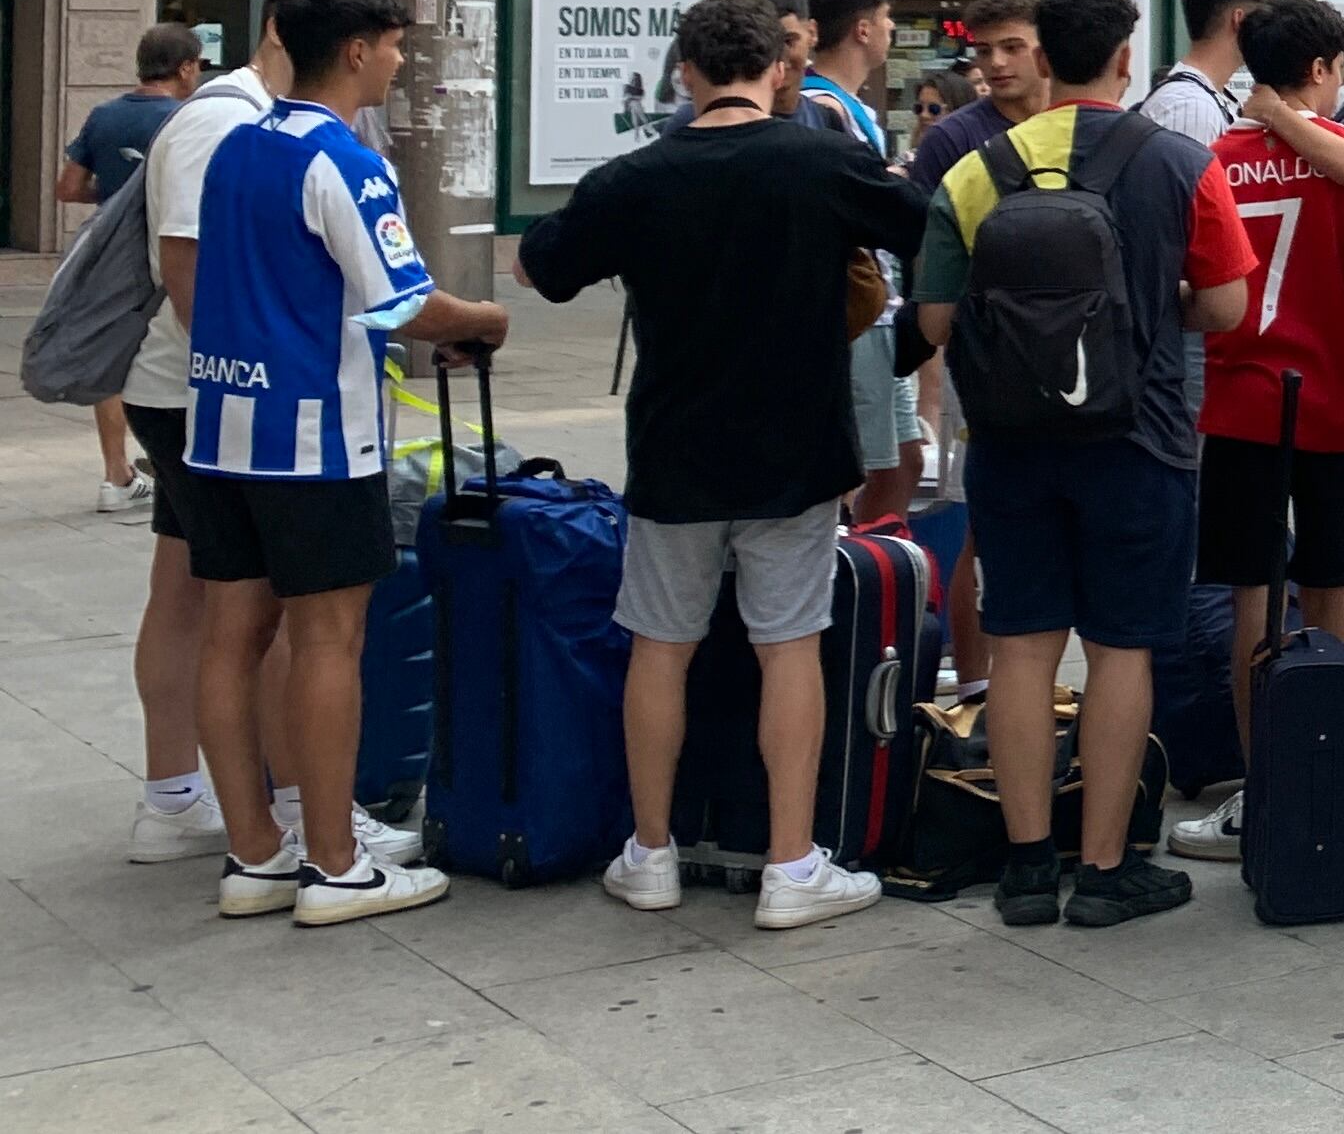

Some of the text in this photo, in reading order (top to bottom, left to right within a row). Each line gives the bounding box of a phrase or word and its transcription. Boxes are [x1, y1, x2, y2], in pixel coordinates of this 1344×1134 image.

[558, 2, 684, 38] SOMOS MÁ
[559, 47, 571, 59] EN
[574, 47, 585, 59] TU
[559, 67, 571, 79] EN
[573, 67, 585, 79] TU
[558, 87, 571, 99] EN
[573, 87, 584, 99] TU
[1236, 197, 1303, 336] 7
